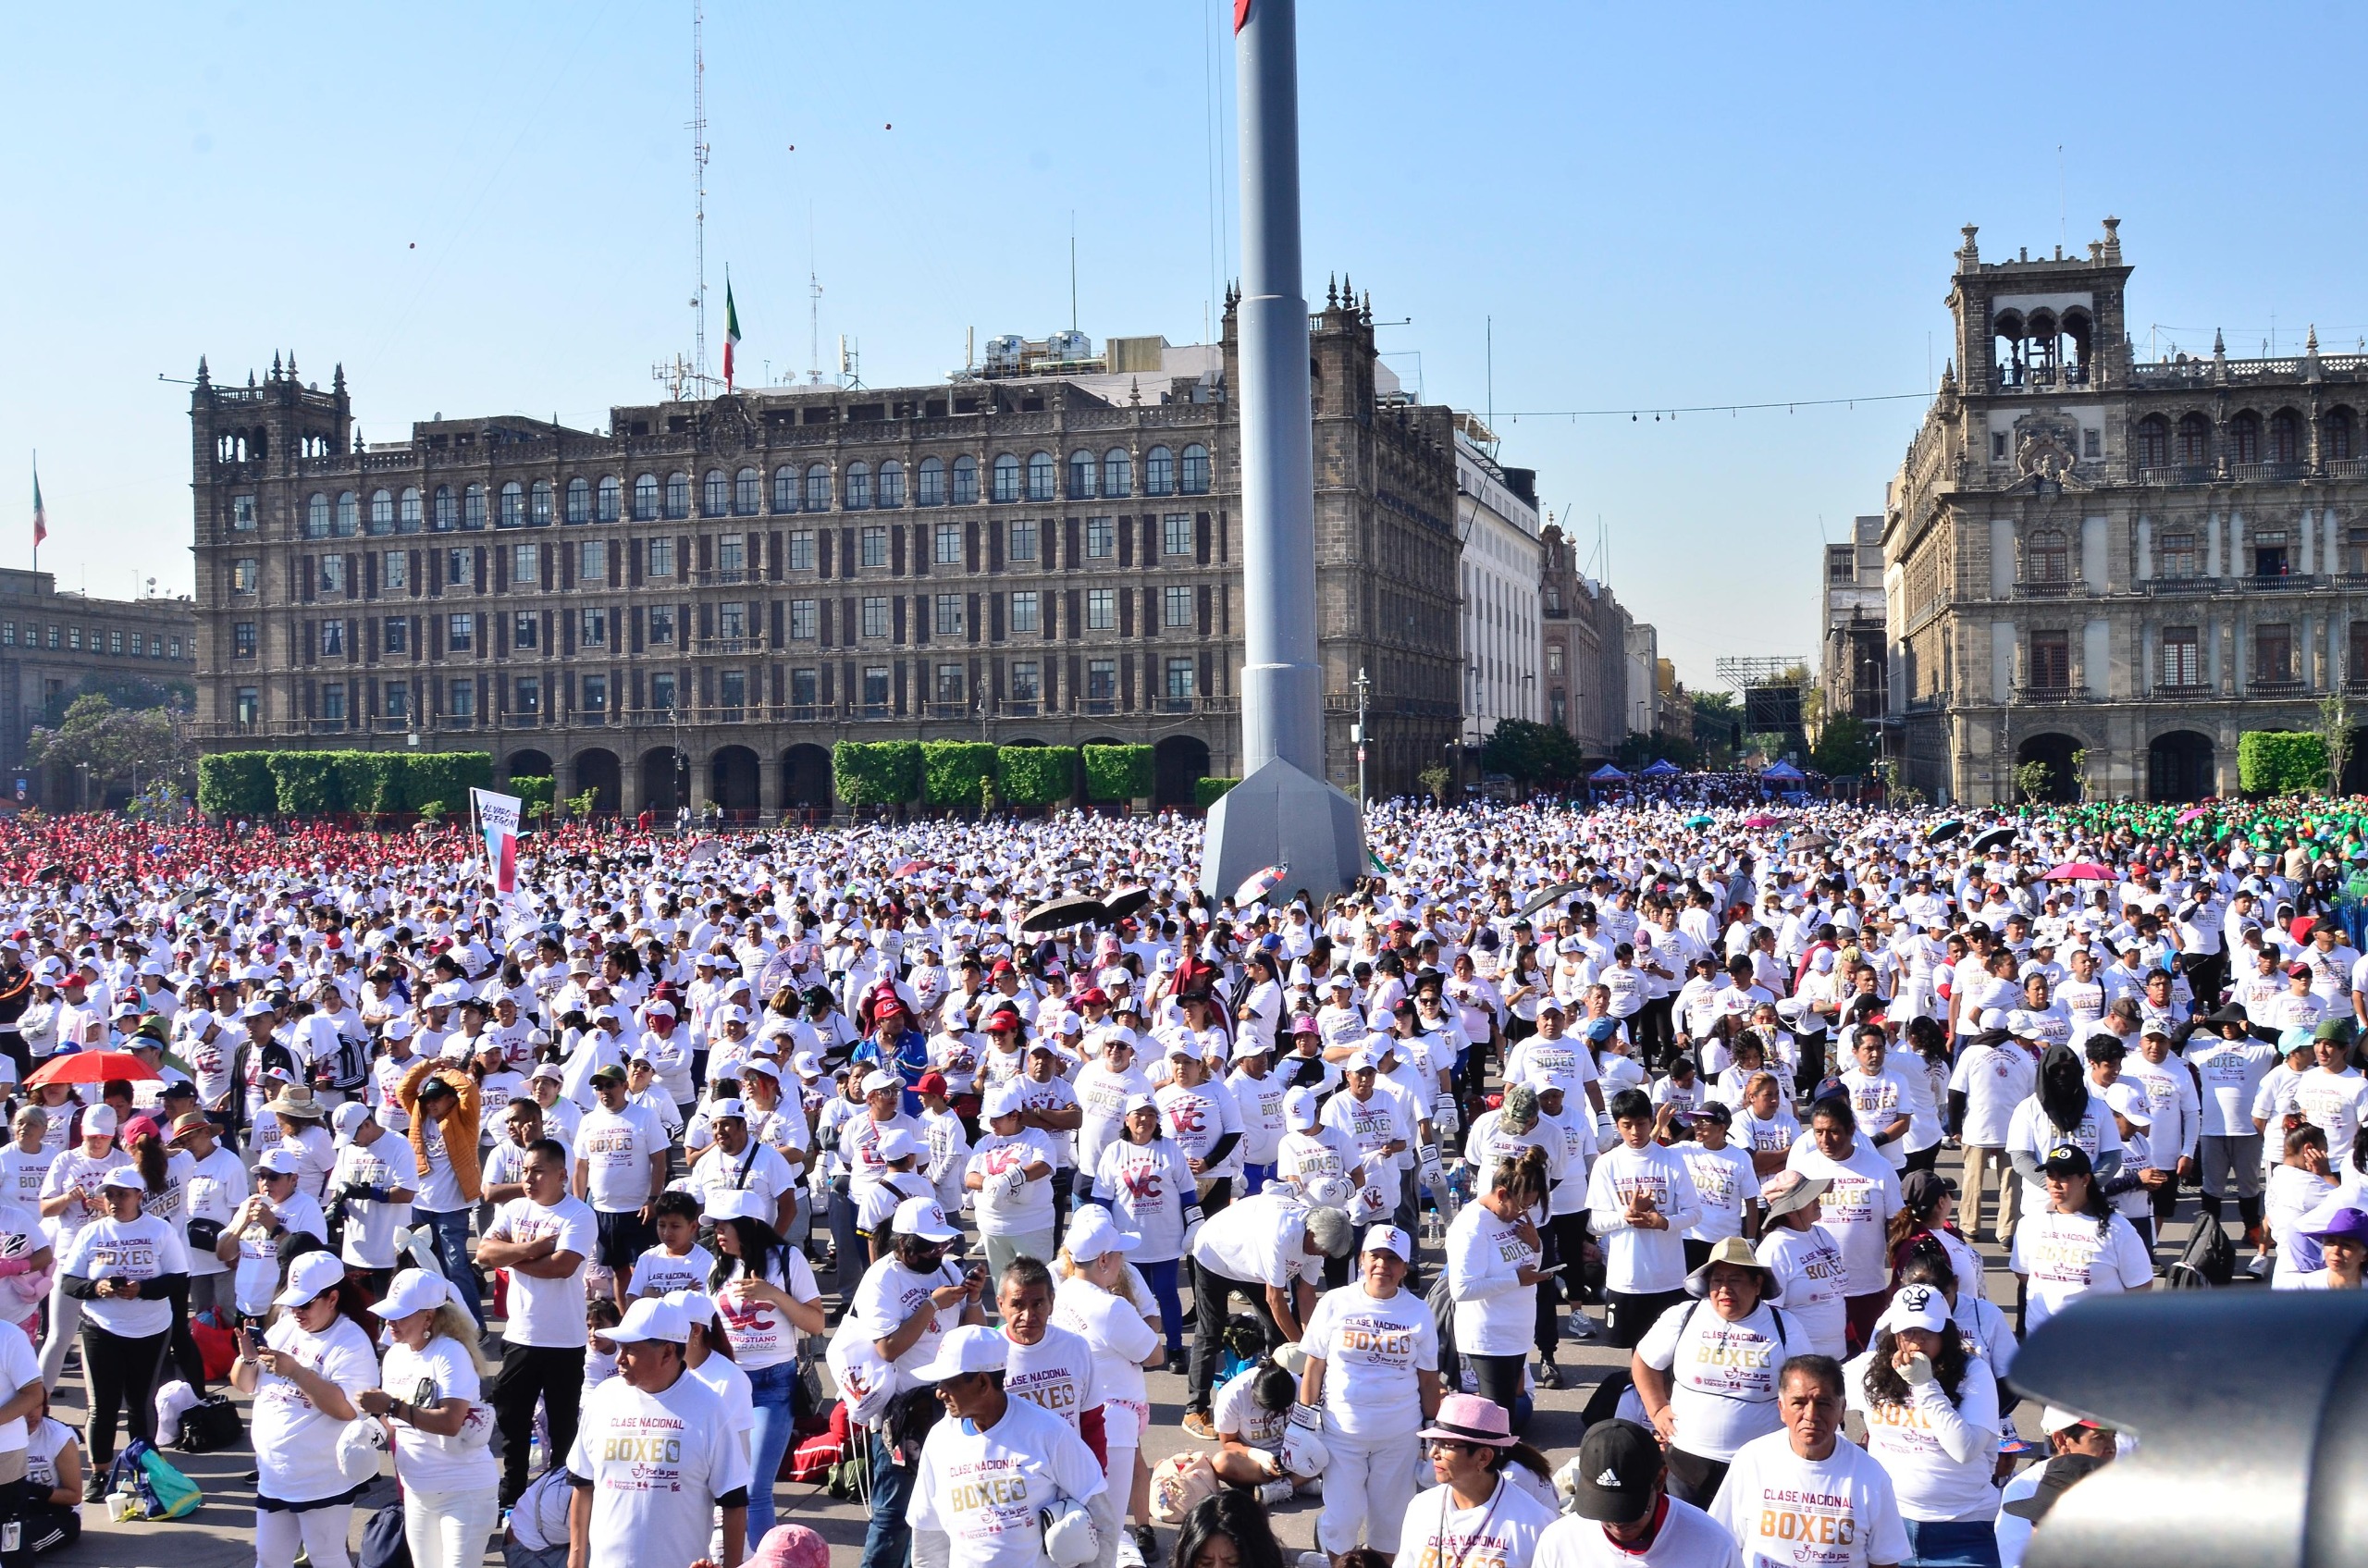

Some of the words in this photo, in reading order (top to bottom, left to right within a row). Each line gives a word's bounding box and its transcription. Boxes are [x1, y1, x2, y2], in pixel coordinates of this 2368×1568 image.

[2073, 999, 2100, 1009] BOXE
[2207, 1056, 2244, 1068] BOXEO
[589, 1137, 633, 1153] BOXEO
[2060, 1148, 2068, 1158] 6
[1298, 1155, 1340, 1174] BOXEO
[1122, 1165, 1163, 1199] VC
[1634, 1176, 1667, 1184] NACIONAL
[96, 1250, 154, 1266] BOXEO
[665, 1271, 693, 1280] NACIONAL
[1345, 1318, 1371, 1327] CLASE
[1373, 1319, 1412, 1331] NACIONAL
[1342, 1330, 1411, 1355] BOXEO
[1702, 1331, 1728, 1340] CLASE
[1729, 1332, 1770, 1343] NACIONAL
[1696, 1346, 1771, 1368] BOXEO
[1030, 1367, 1071, 1381] NACIONAL
[610, 1417, 636, 1427] CLASE
[638, 1417, 684, 1430] NACIONAL
[604, 1438, 681, 1463] BOXEO
[646, 1467, 657, 1475] Por
[667, 1470, 679, 1478] paz
[950, 1463, 972, 1477] CLASE
[974, 1457, 1021, 1473] NACIONAL
[1596, 1478, 1622, 1487] adidas
[951, 1476, 1028, 1512] BOXEO
[1764, 1488, 1798, 1501] CLASE
[1801, 1492, 1854, 1509] NACIONAL
[994, 1509, 1006, 1518] Por
[1017, 1505, 1029, 1516] paz
[1805, 1505, 1812, 1513] DE
[1760, 1510, 1855, 1545] BOXEO
[1812, 1550, 1827, 1560] Por
[1828, 1550, 1836, 1559] la
[1836, 1552, 1850, 1562] paz
